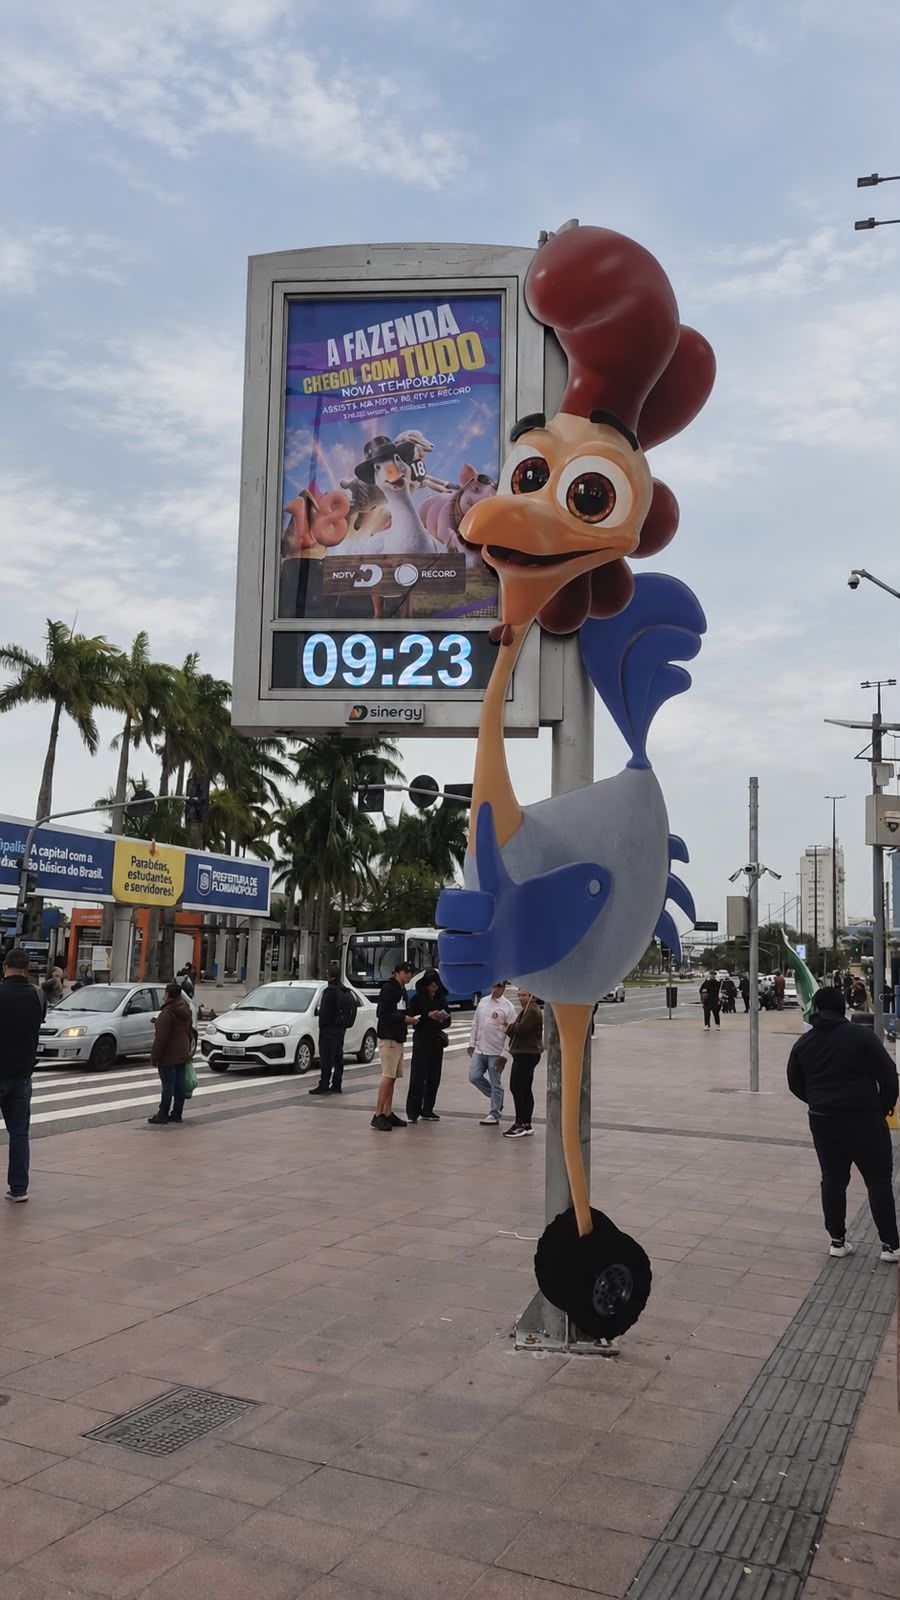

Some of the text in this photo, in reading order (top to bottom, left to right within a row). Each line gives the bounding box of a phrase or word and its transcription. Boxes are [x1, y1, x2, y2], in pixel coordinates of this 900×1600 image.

[327, 303, 461, 367] A FAZENDA
[361, 357, 401, 385] COM
[400, 331, 486, 378] TUDO
[342, 372, 456, 398] NOVA TEMPORADA
[410, 460, 426, 477] 18
[284, 489, 350, 549] 18
[332, 571, 356, 580] NDTV
[421, 569, 457, 579] RECORD
[302, 633, 473, 687] 09:23
[370, 705, 422, 721] sinergy
[30, 843, 38, 855] A
[38, 846, 68, 861] capital
[69, 850, 86, 862] com
[87, 854, 93, 863] a
[67, 864, 79, 876] do
[79, 866, 104, 879] Brasil.
[131, 855, 170, 874] Parabéns,
[127, 870, 173, 885] estudantes
[249, 877, 258, 887] DE
[124, 882, 174, 897] e servidores!
